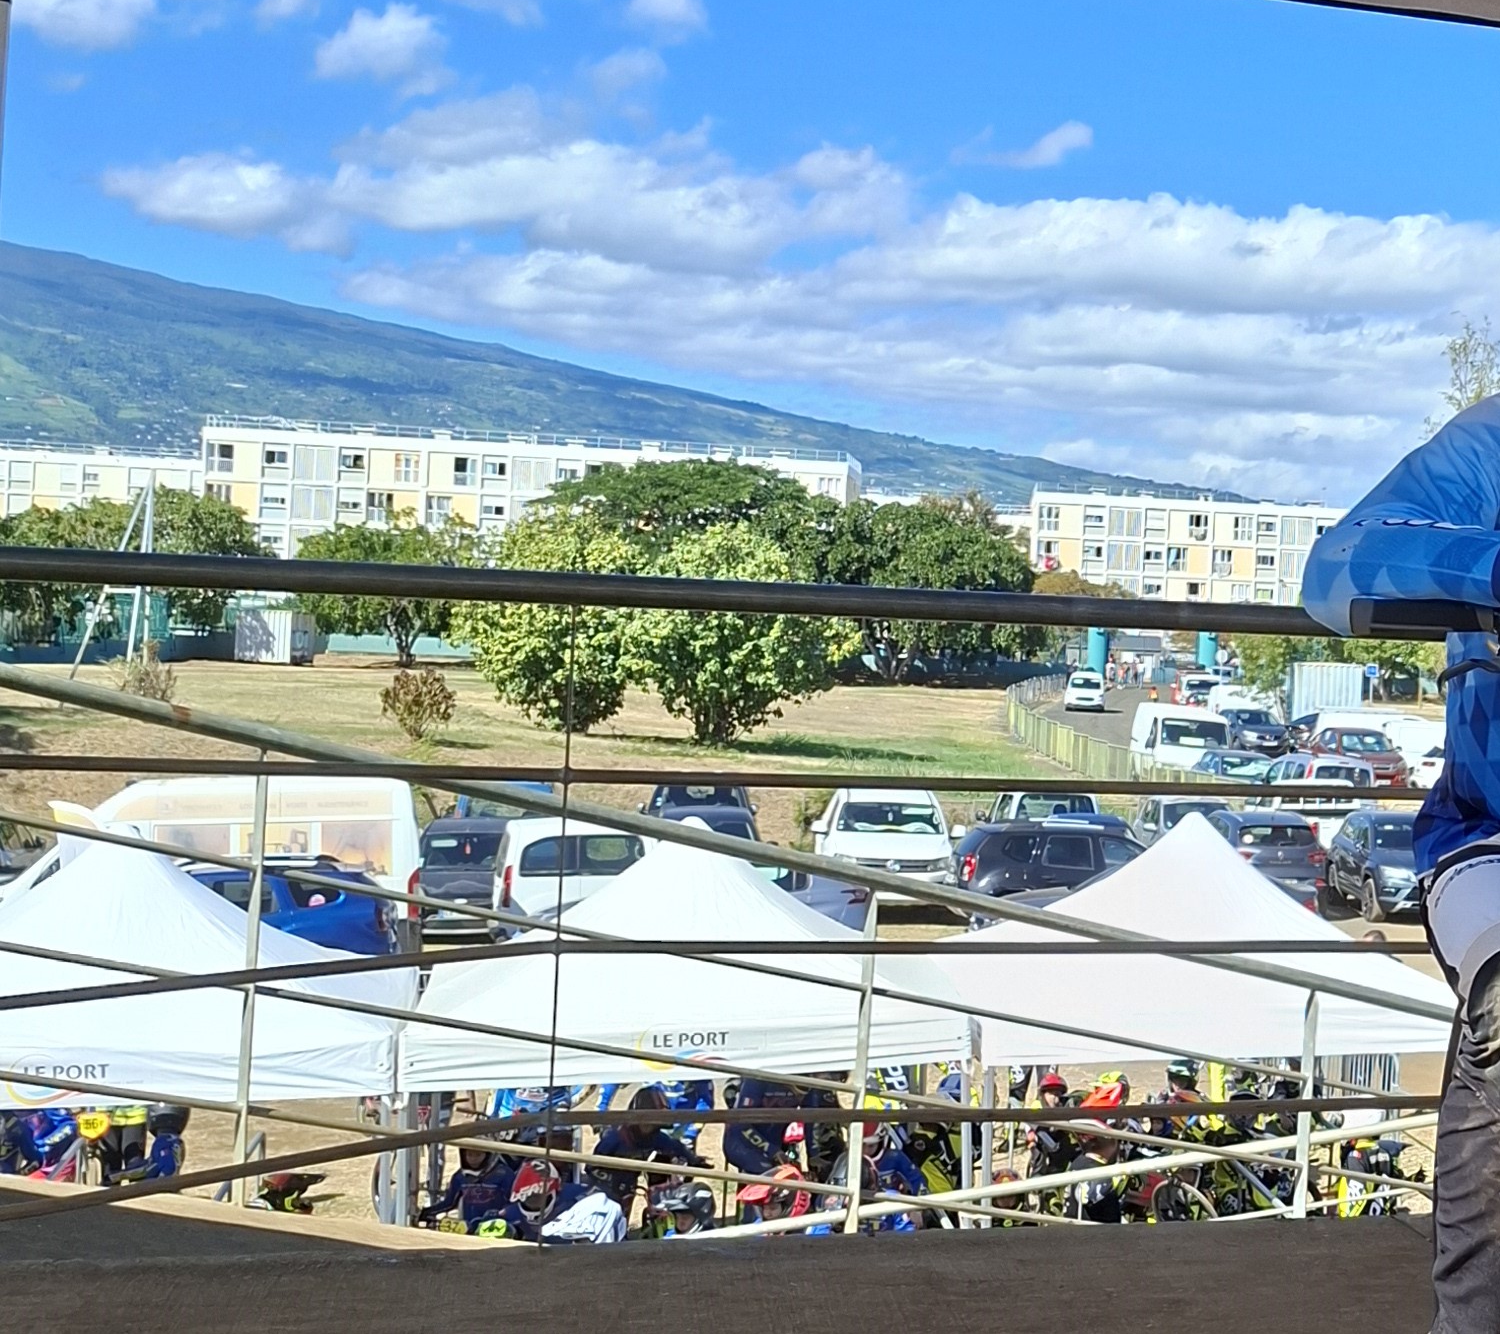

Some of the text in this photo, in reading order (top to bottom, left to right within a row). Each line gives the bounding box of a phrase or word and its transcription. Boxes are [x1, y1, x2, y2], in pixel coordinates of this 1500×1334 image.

[653, 1030, 730, 1048] LE PORT
[52, 1063, 110, 1080] PORT
